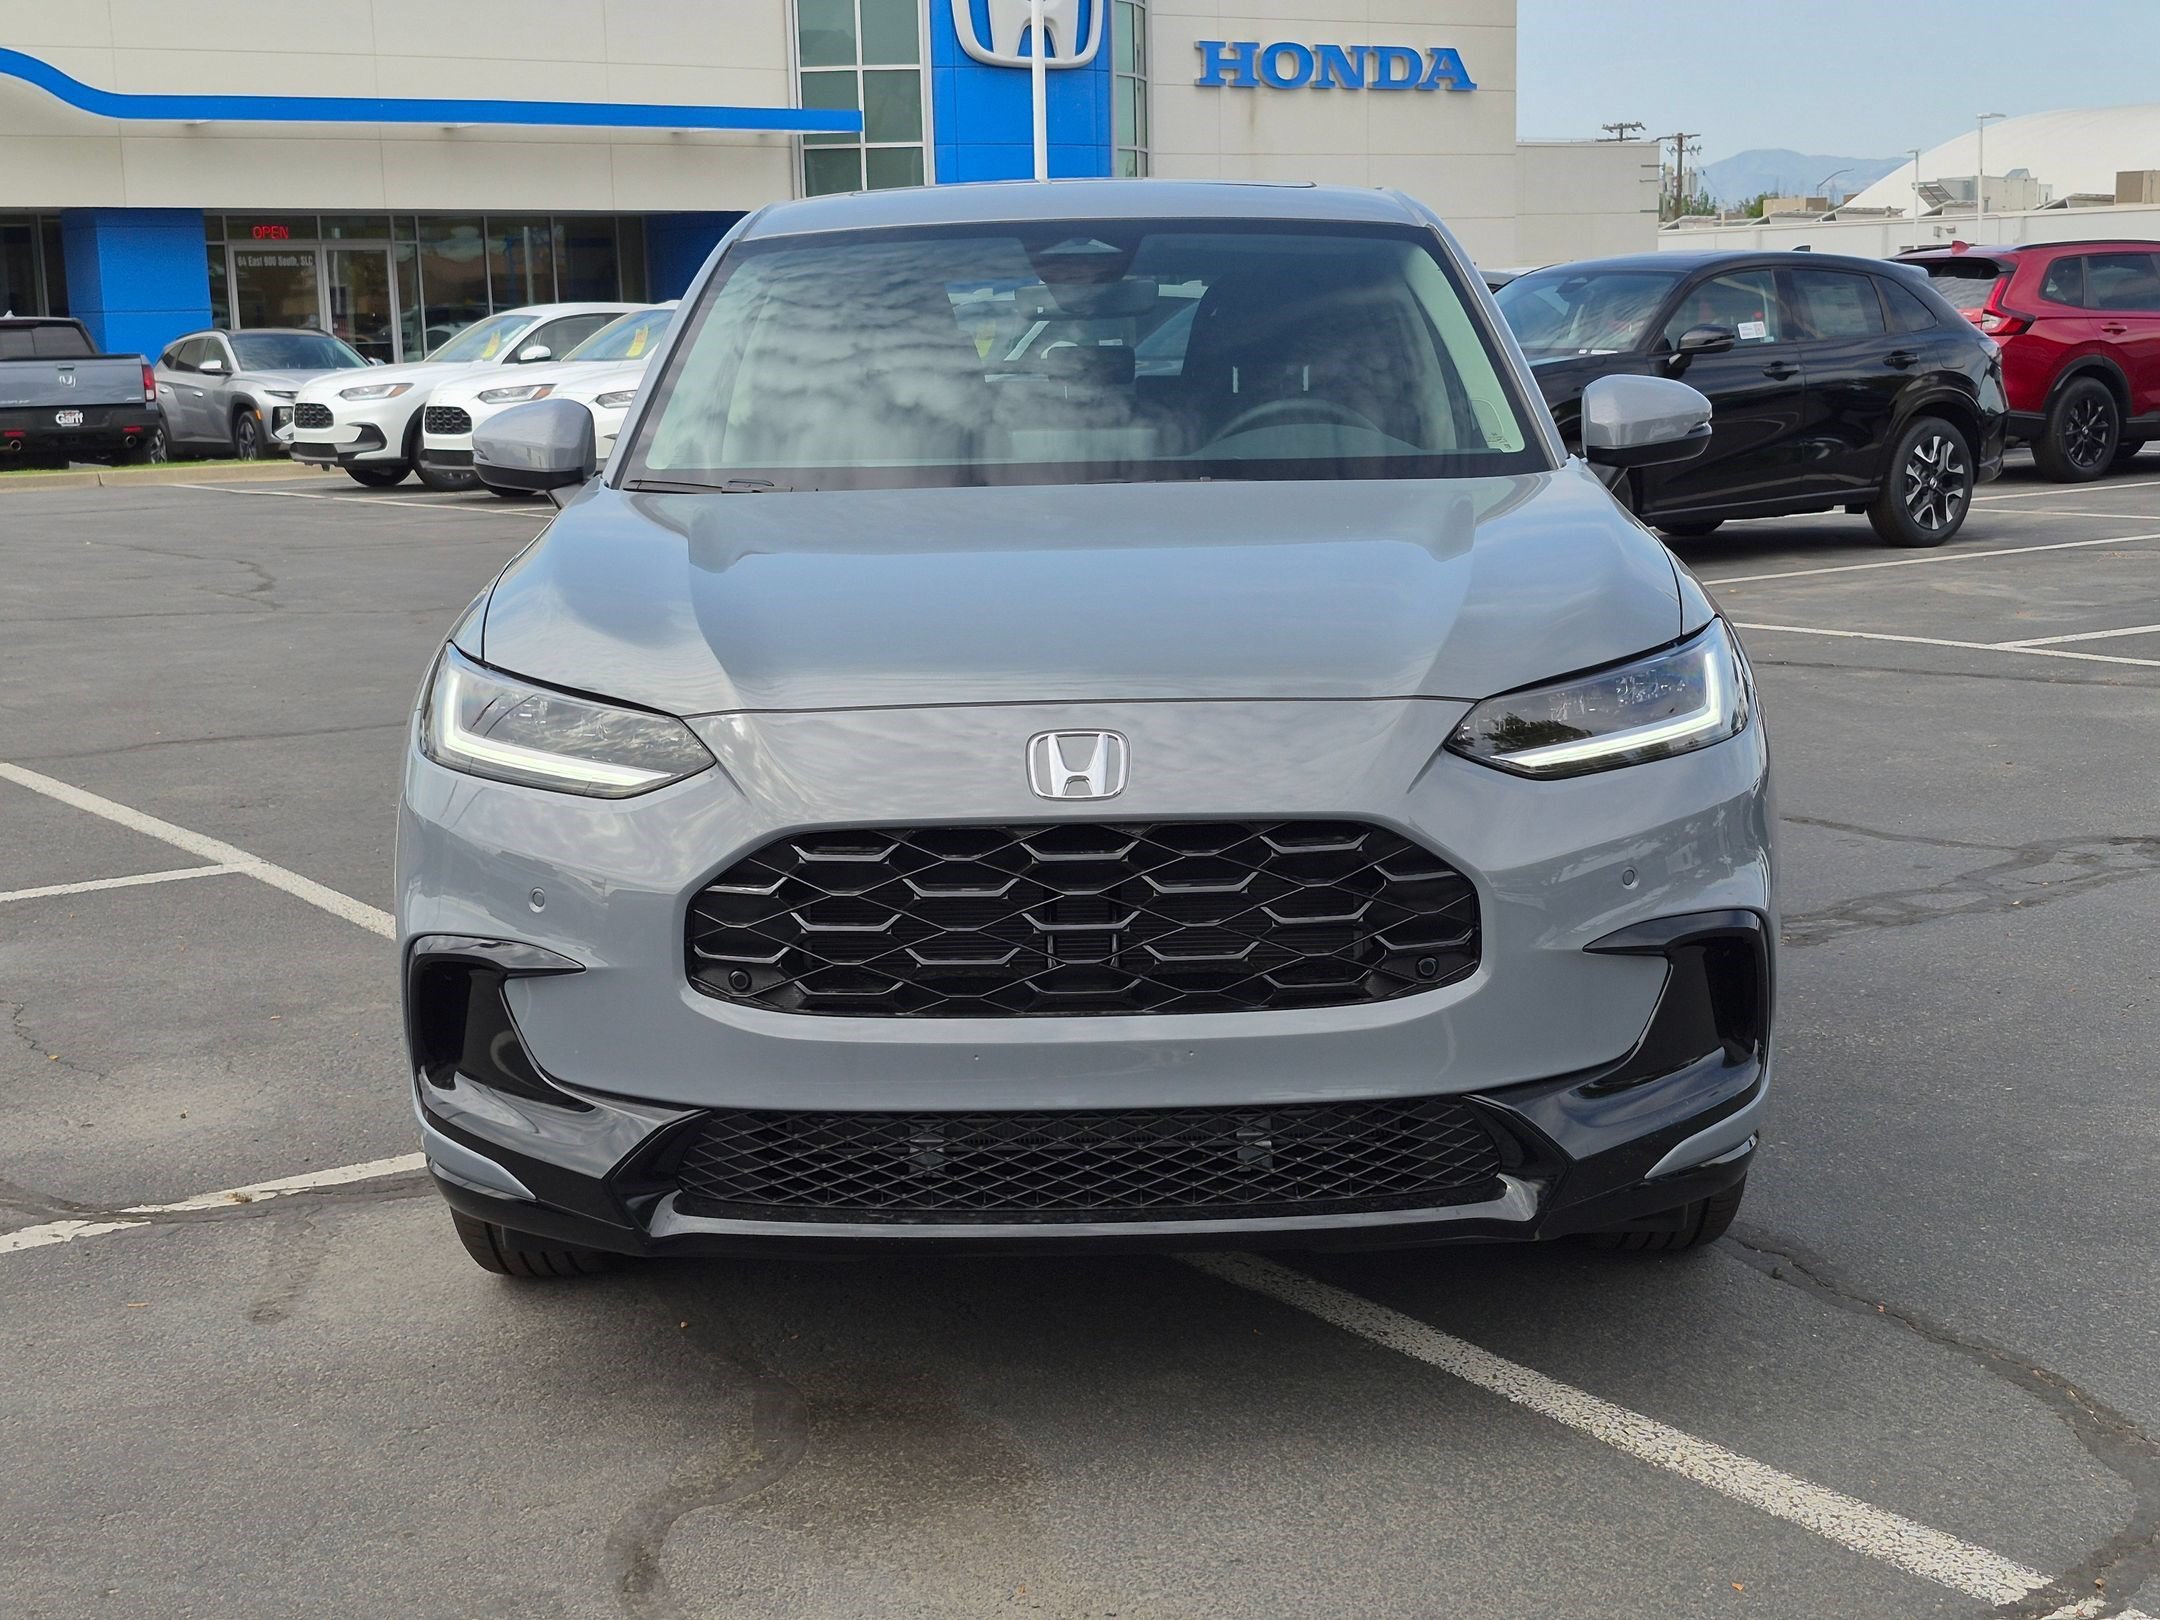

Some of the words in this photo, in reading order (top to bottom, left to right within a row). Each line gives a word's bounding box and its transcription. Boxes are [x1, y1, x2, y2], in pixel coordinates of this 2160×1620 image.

[1195, 40, 1477, 91] HONDA
[252, 225, 289, 240] OPEN
[248, 256, 262, 267] East
[300, 256, 313, 267] SLC
